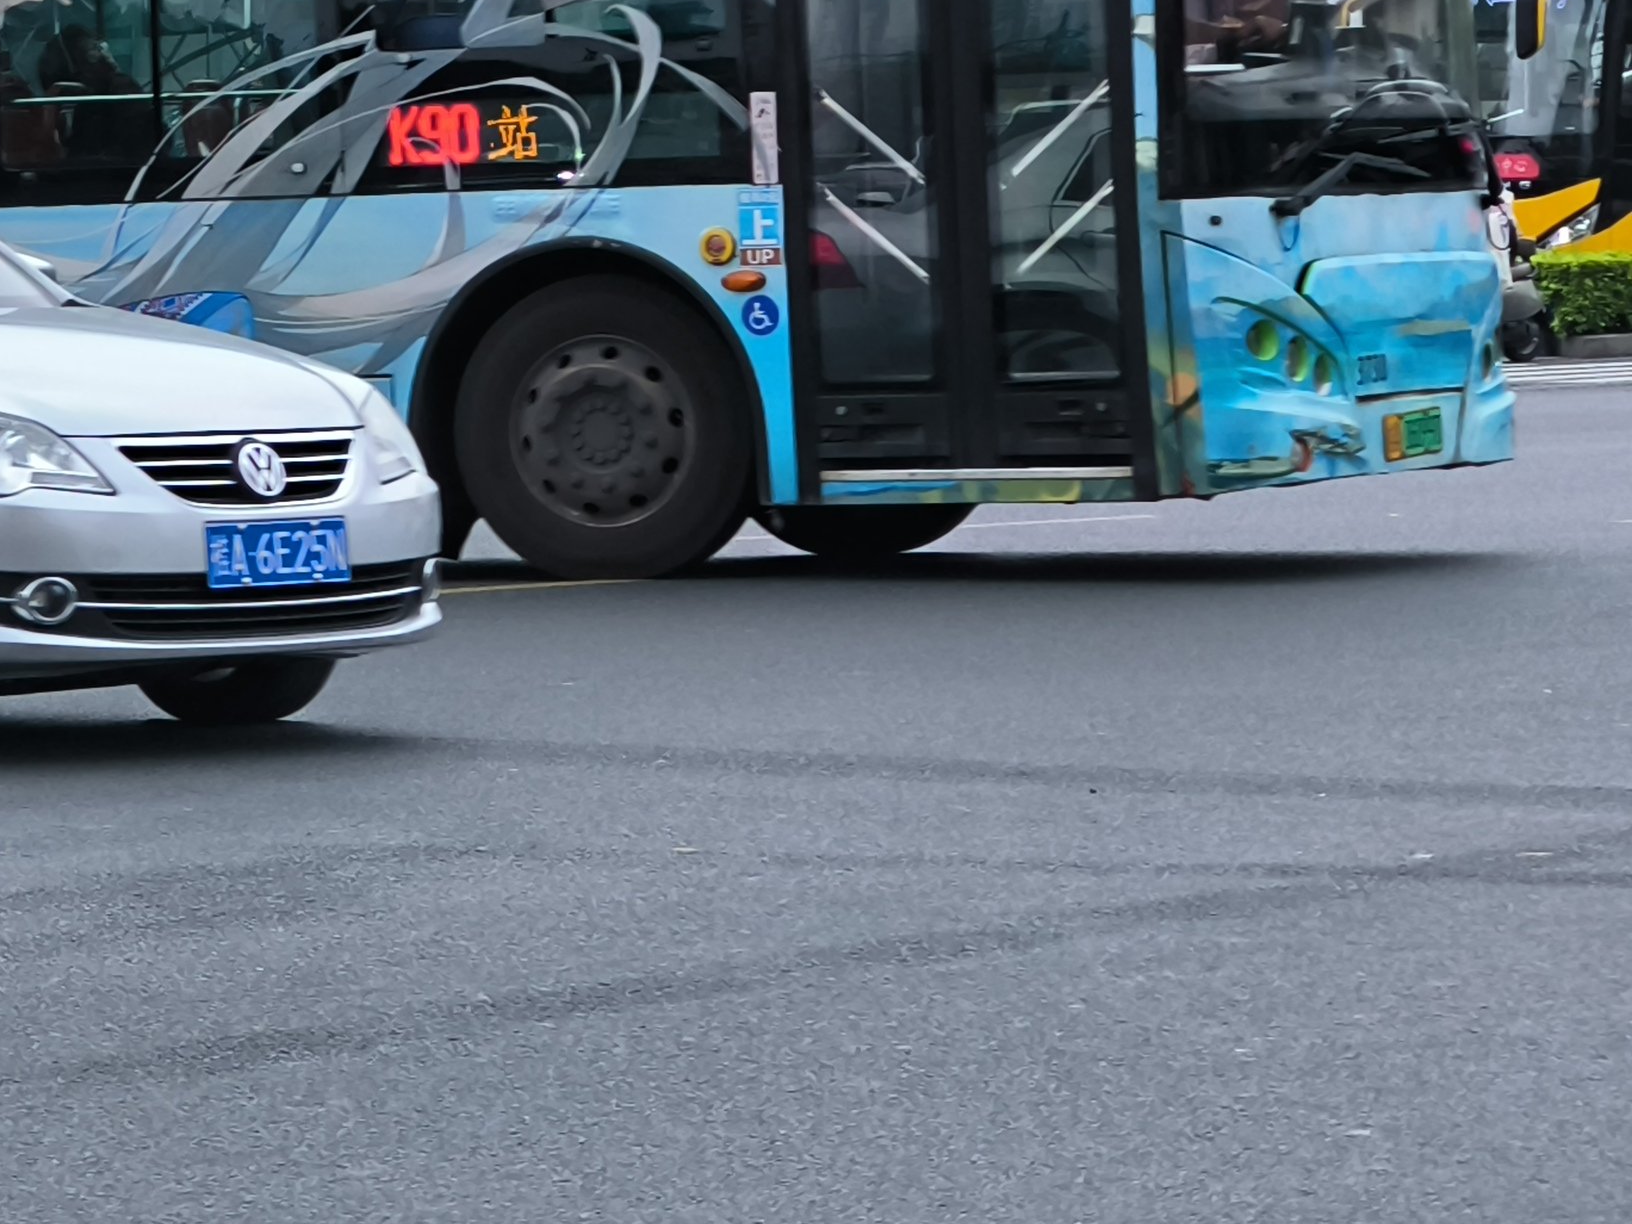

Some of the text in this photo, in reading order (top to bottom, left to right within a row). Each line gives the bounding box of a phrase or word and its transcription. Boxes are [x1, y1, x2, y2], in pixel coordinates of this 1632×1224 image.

[387, 102, 539, 167] K90 站
[741, 208, 778, 246] 上
[745, 248, 776, 265] UP
